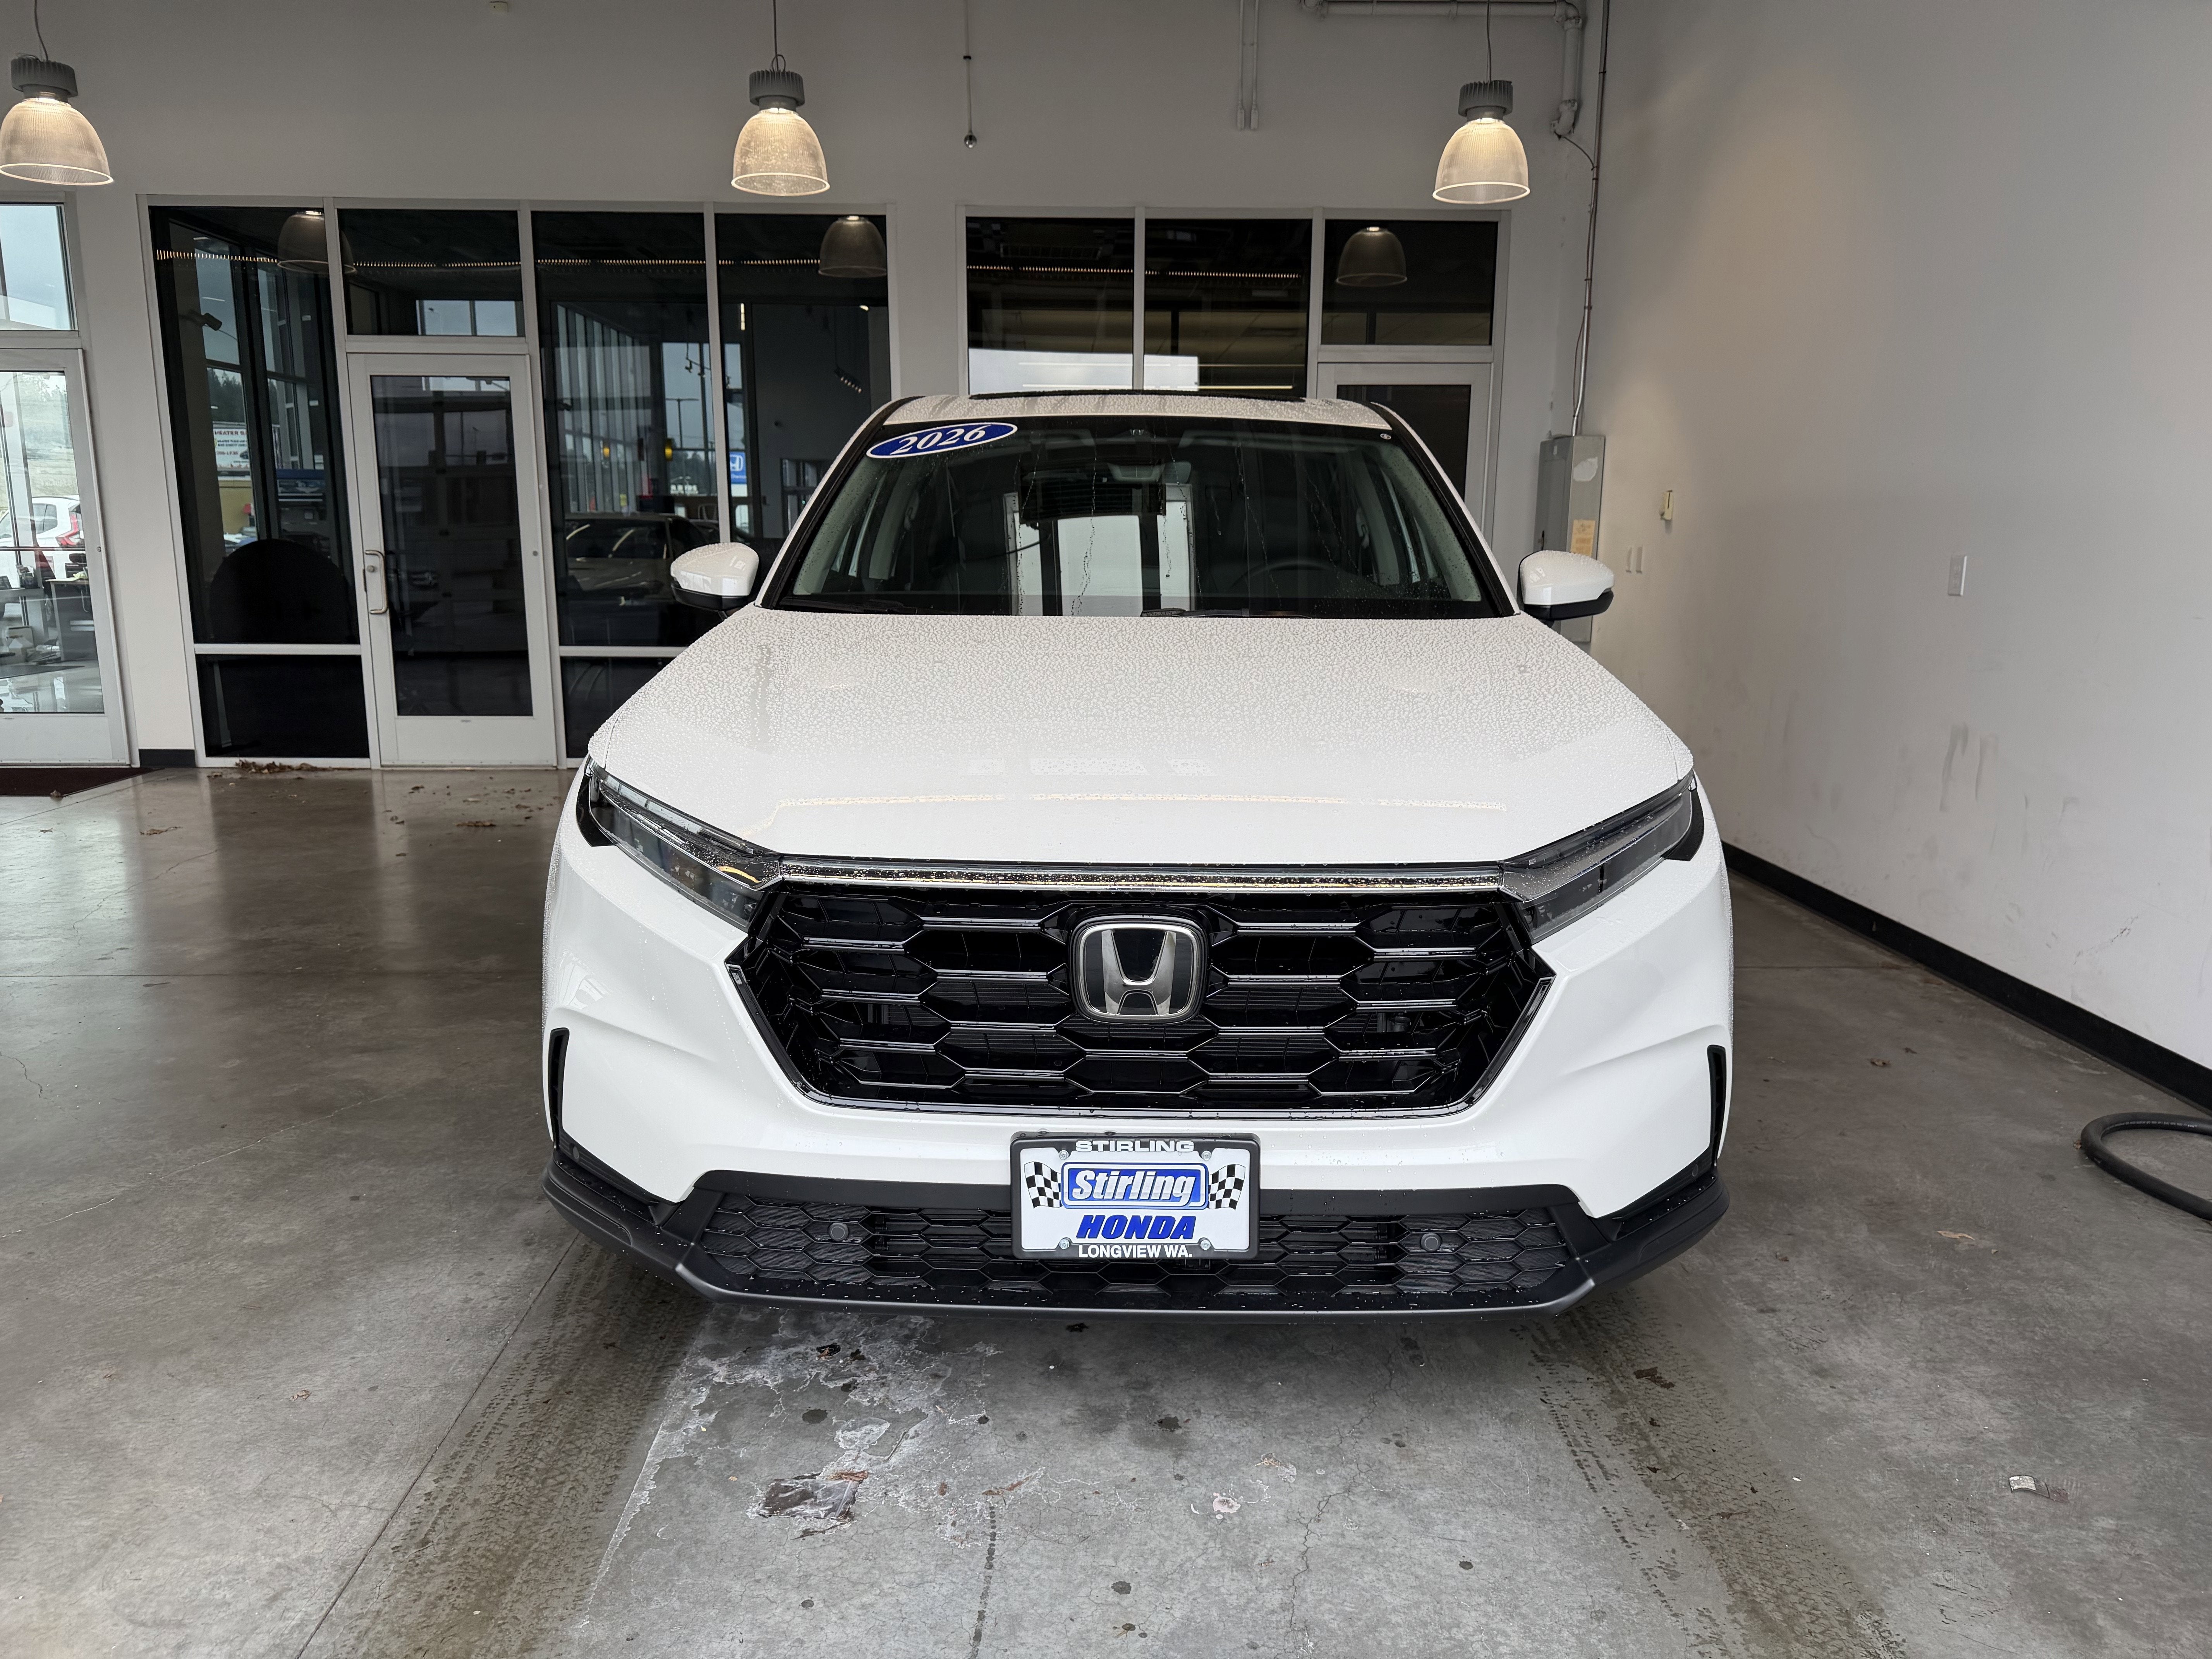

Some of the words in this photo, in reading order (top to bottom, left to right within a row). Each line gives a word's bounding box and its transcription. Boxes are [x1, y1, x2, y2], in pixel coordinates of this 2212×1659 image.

[890, 424, 992, 455] 2026
[1075, 1140, 1194, 1152] STIRLING
[1072, 1170, 1196, 1207] Stirling
[1076, 1214, 1196, 1239] HONDA
[1079, 1245, 1161, 1258] LONGVIEW
[1164, 1245, 1192, 1258] WA.
